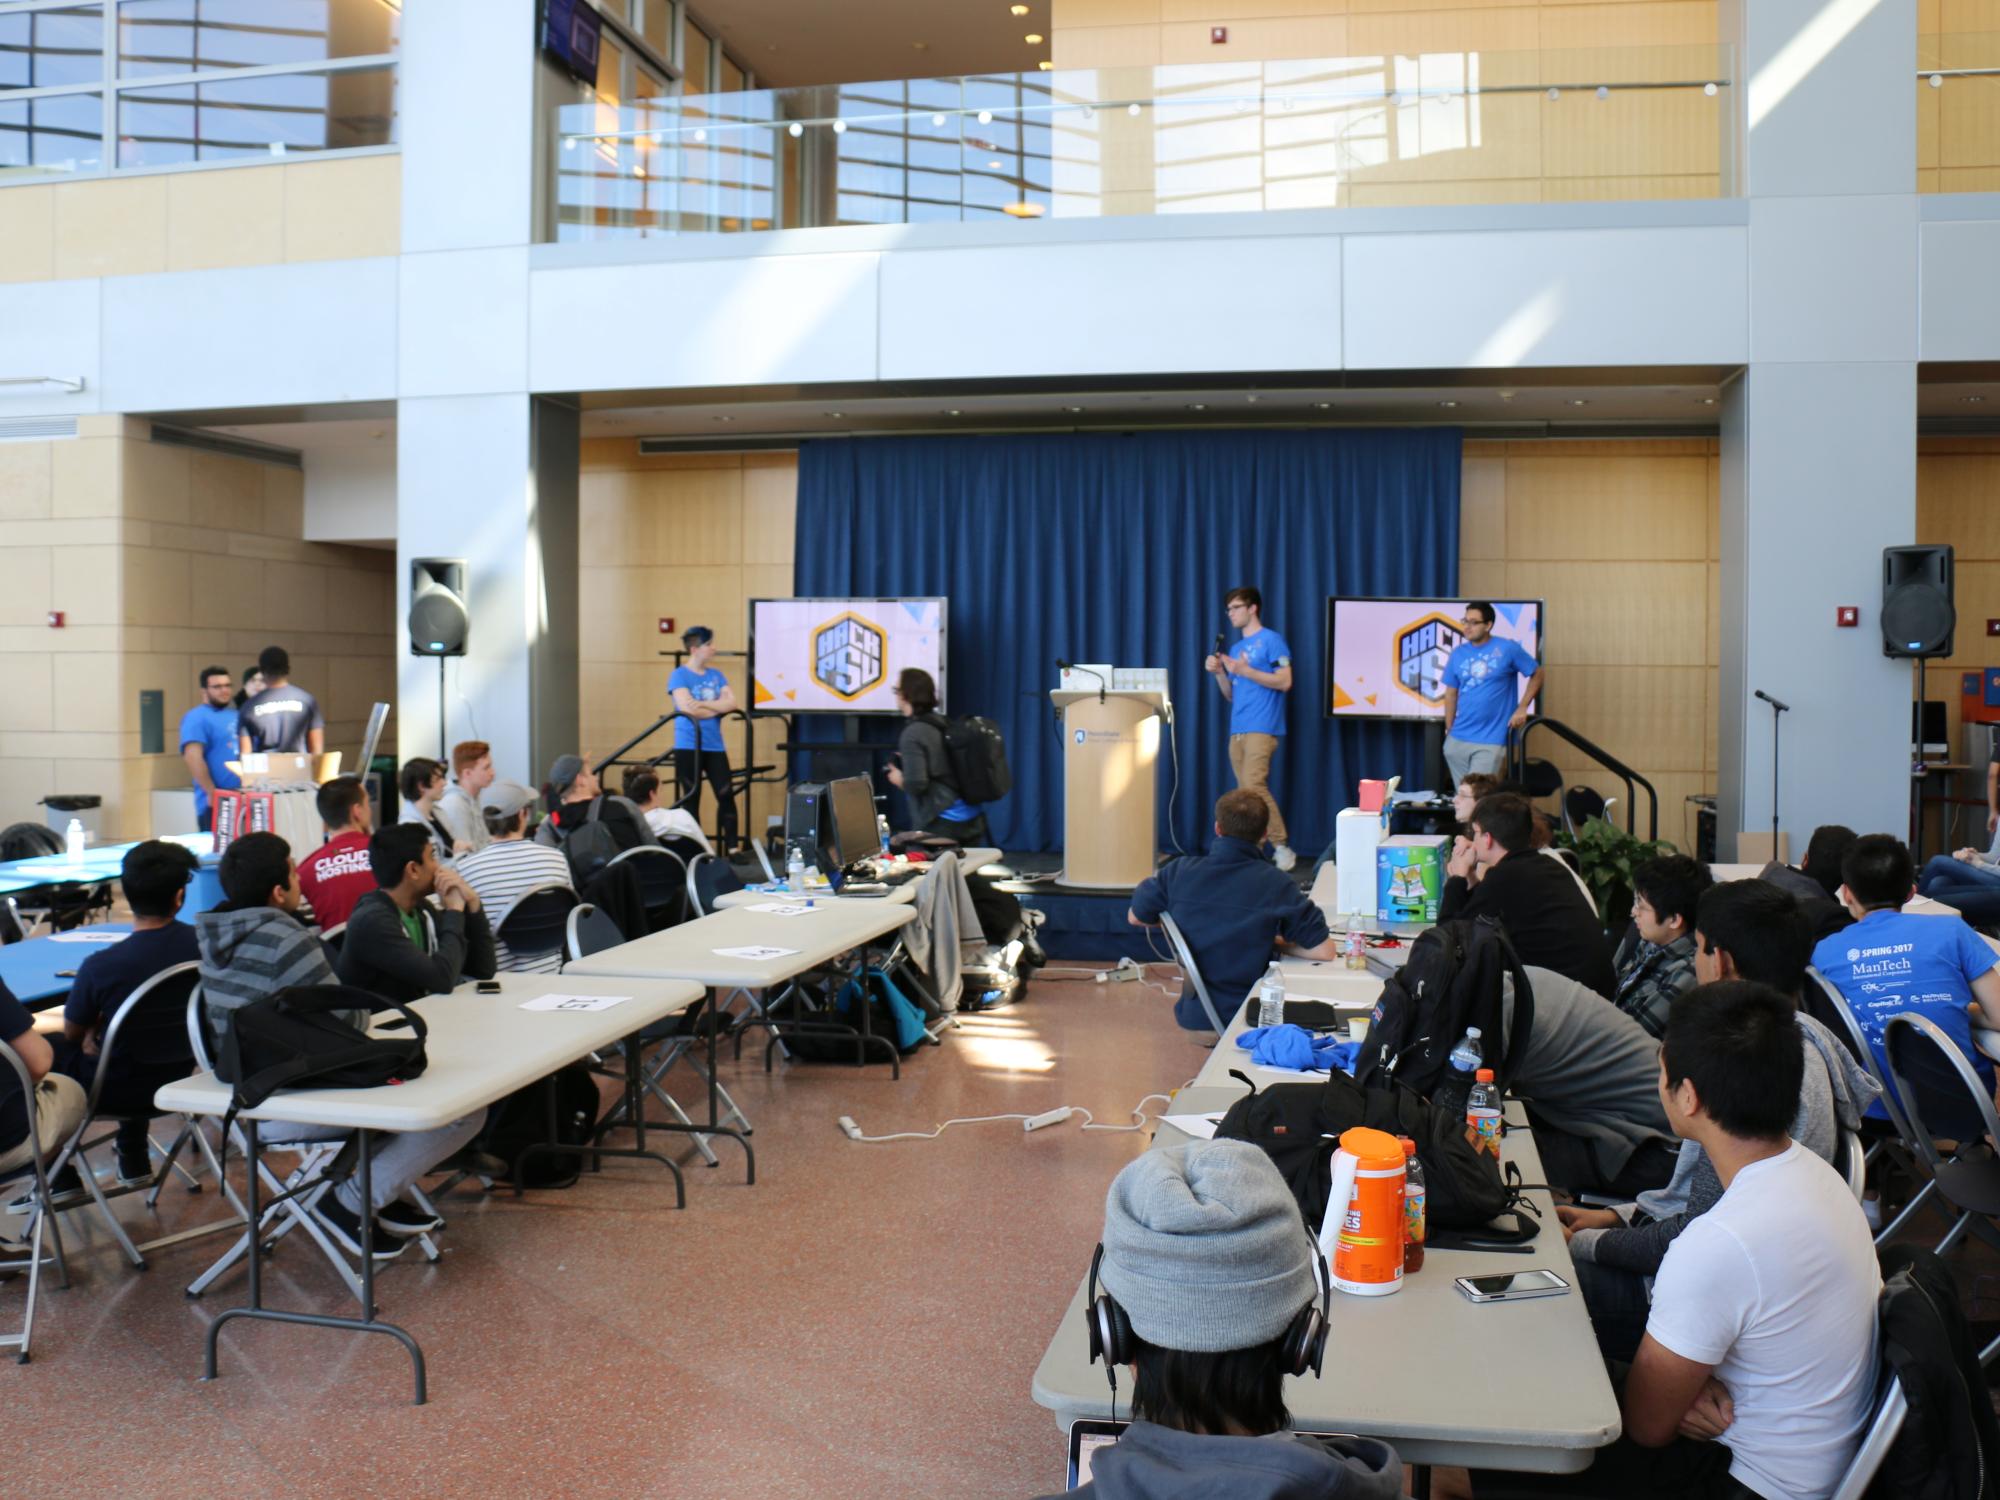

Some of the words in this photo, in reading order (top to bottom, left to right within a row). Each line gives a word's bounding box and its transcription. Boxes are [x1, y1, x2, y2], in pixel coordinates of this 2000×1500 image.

[315, 849, 370, 871] CLOUD
[316, 860, 372, 882] HOSTING
[1862, 945, 1892, 957] SPRING
[1893, 943, 1913, 953] 2017
[1853, 958, 1911, 974] ManTech
